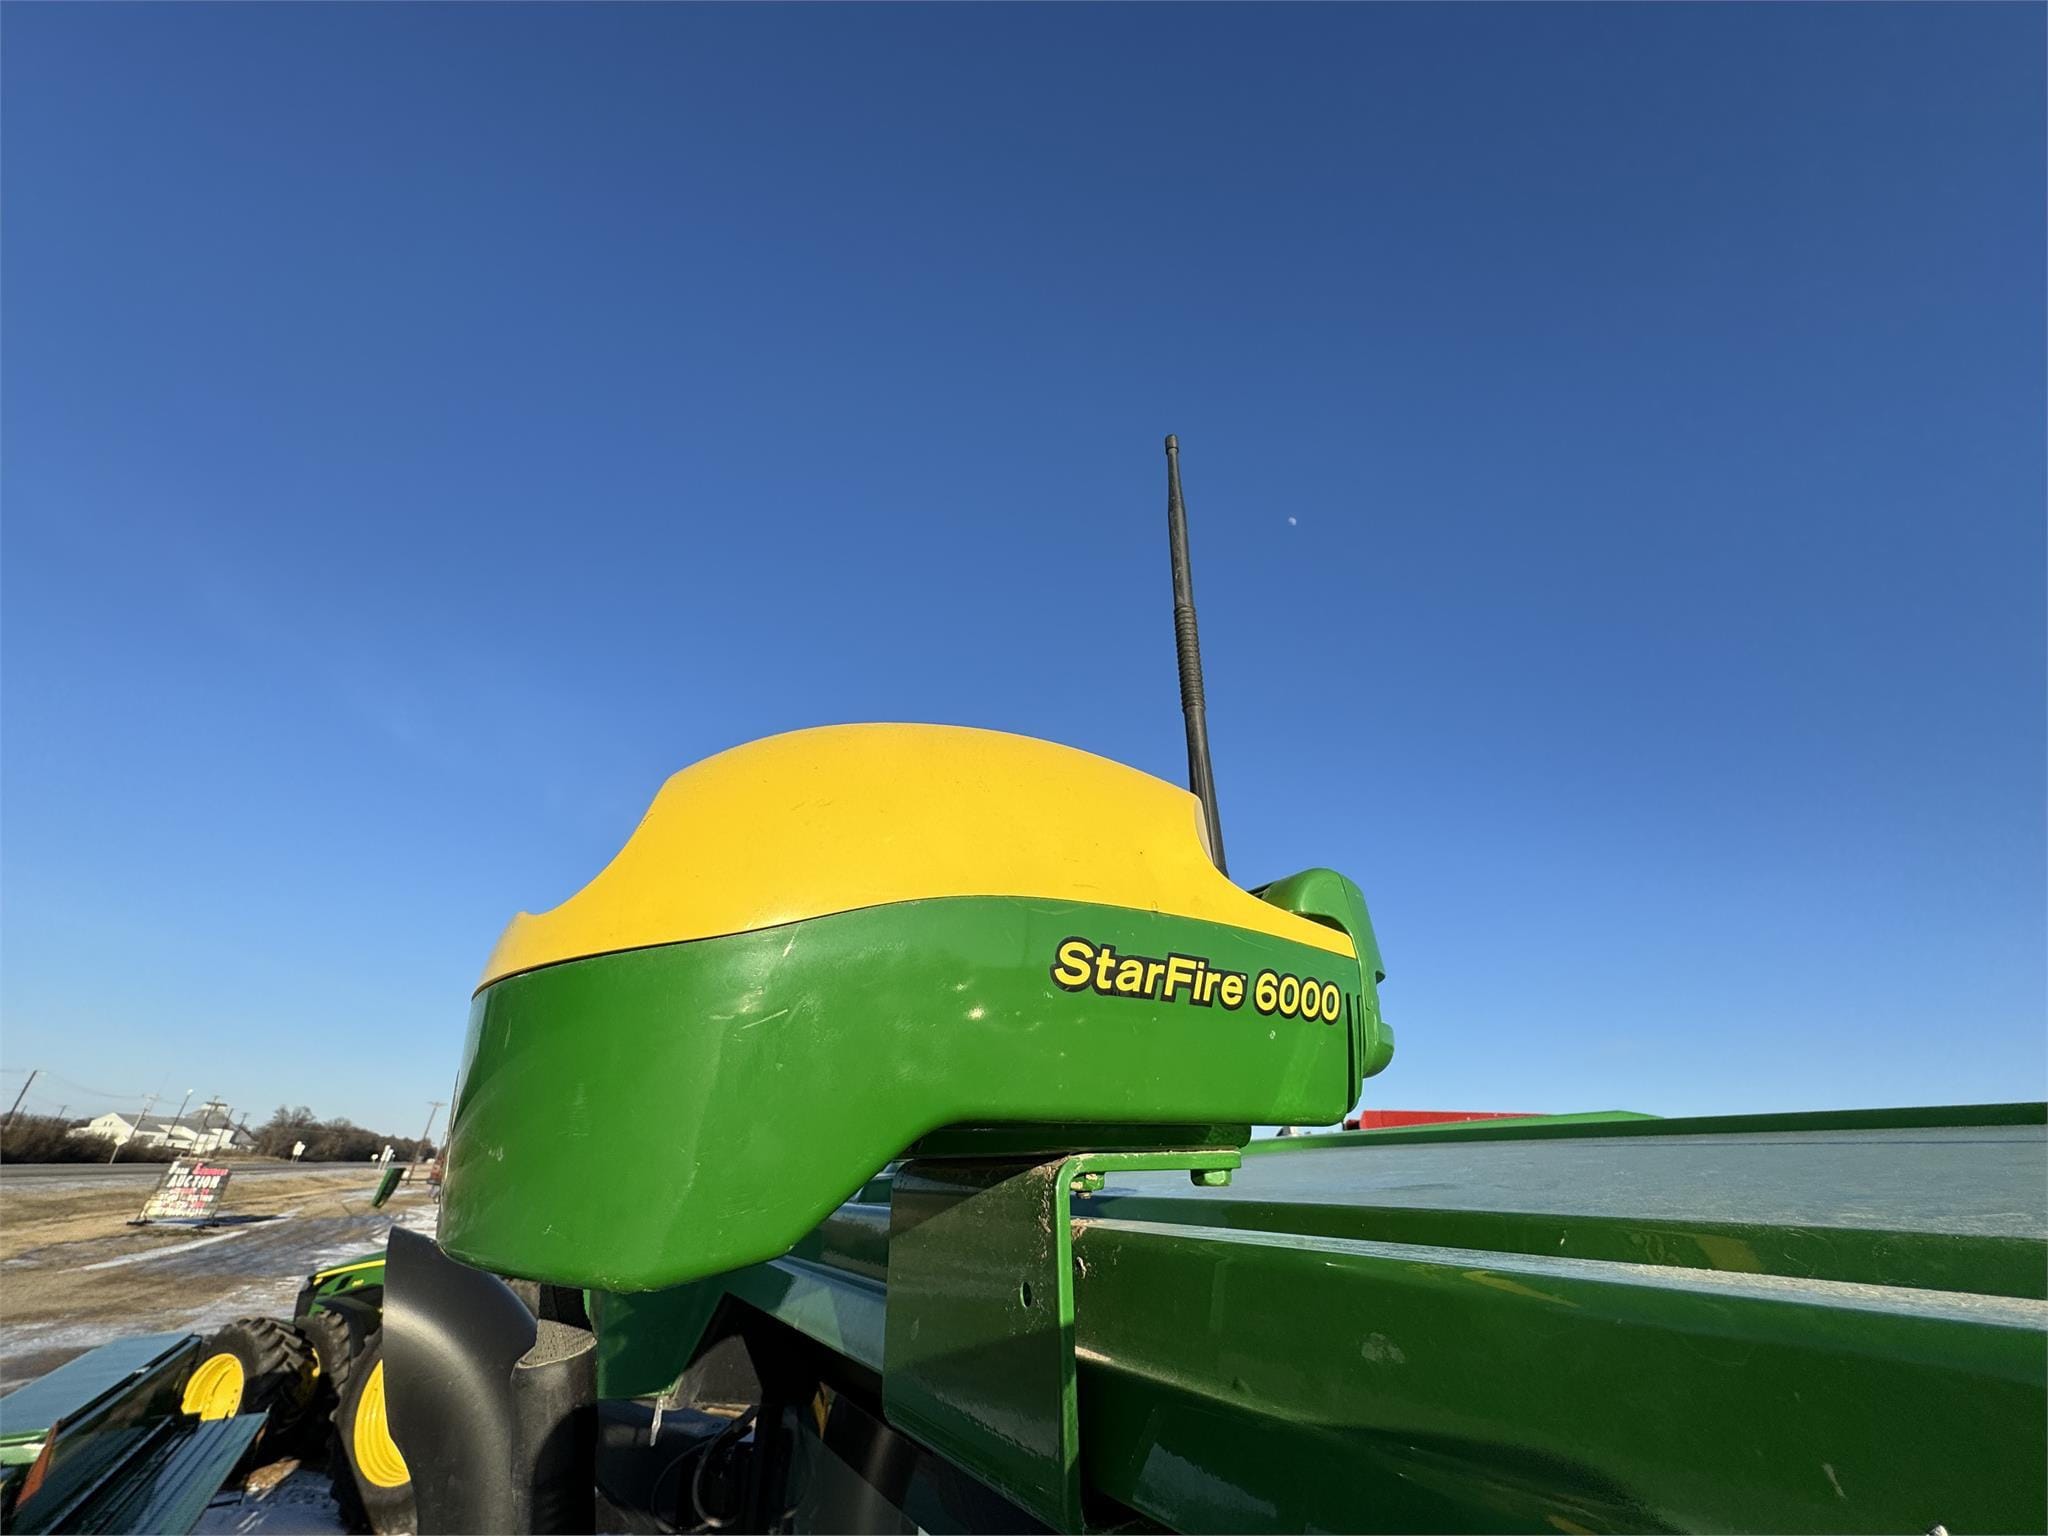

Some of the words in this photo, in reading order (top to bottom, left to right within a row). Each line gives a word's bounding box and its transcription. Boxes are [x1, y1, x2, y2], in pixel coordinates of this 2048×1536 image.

[1052, 938, 1245, 1008] StarFire
[1254, 971, 1341, 1022] 6000
[166, 1175, 221, 1189] AUCTION
